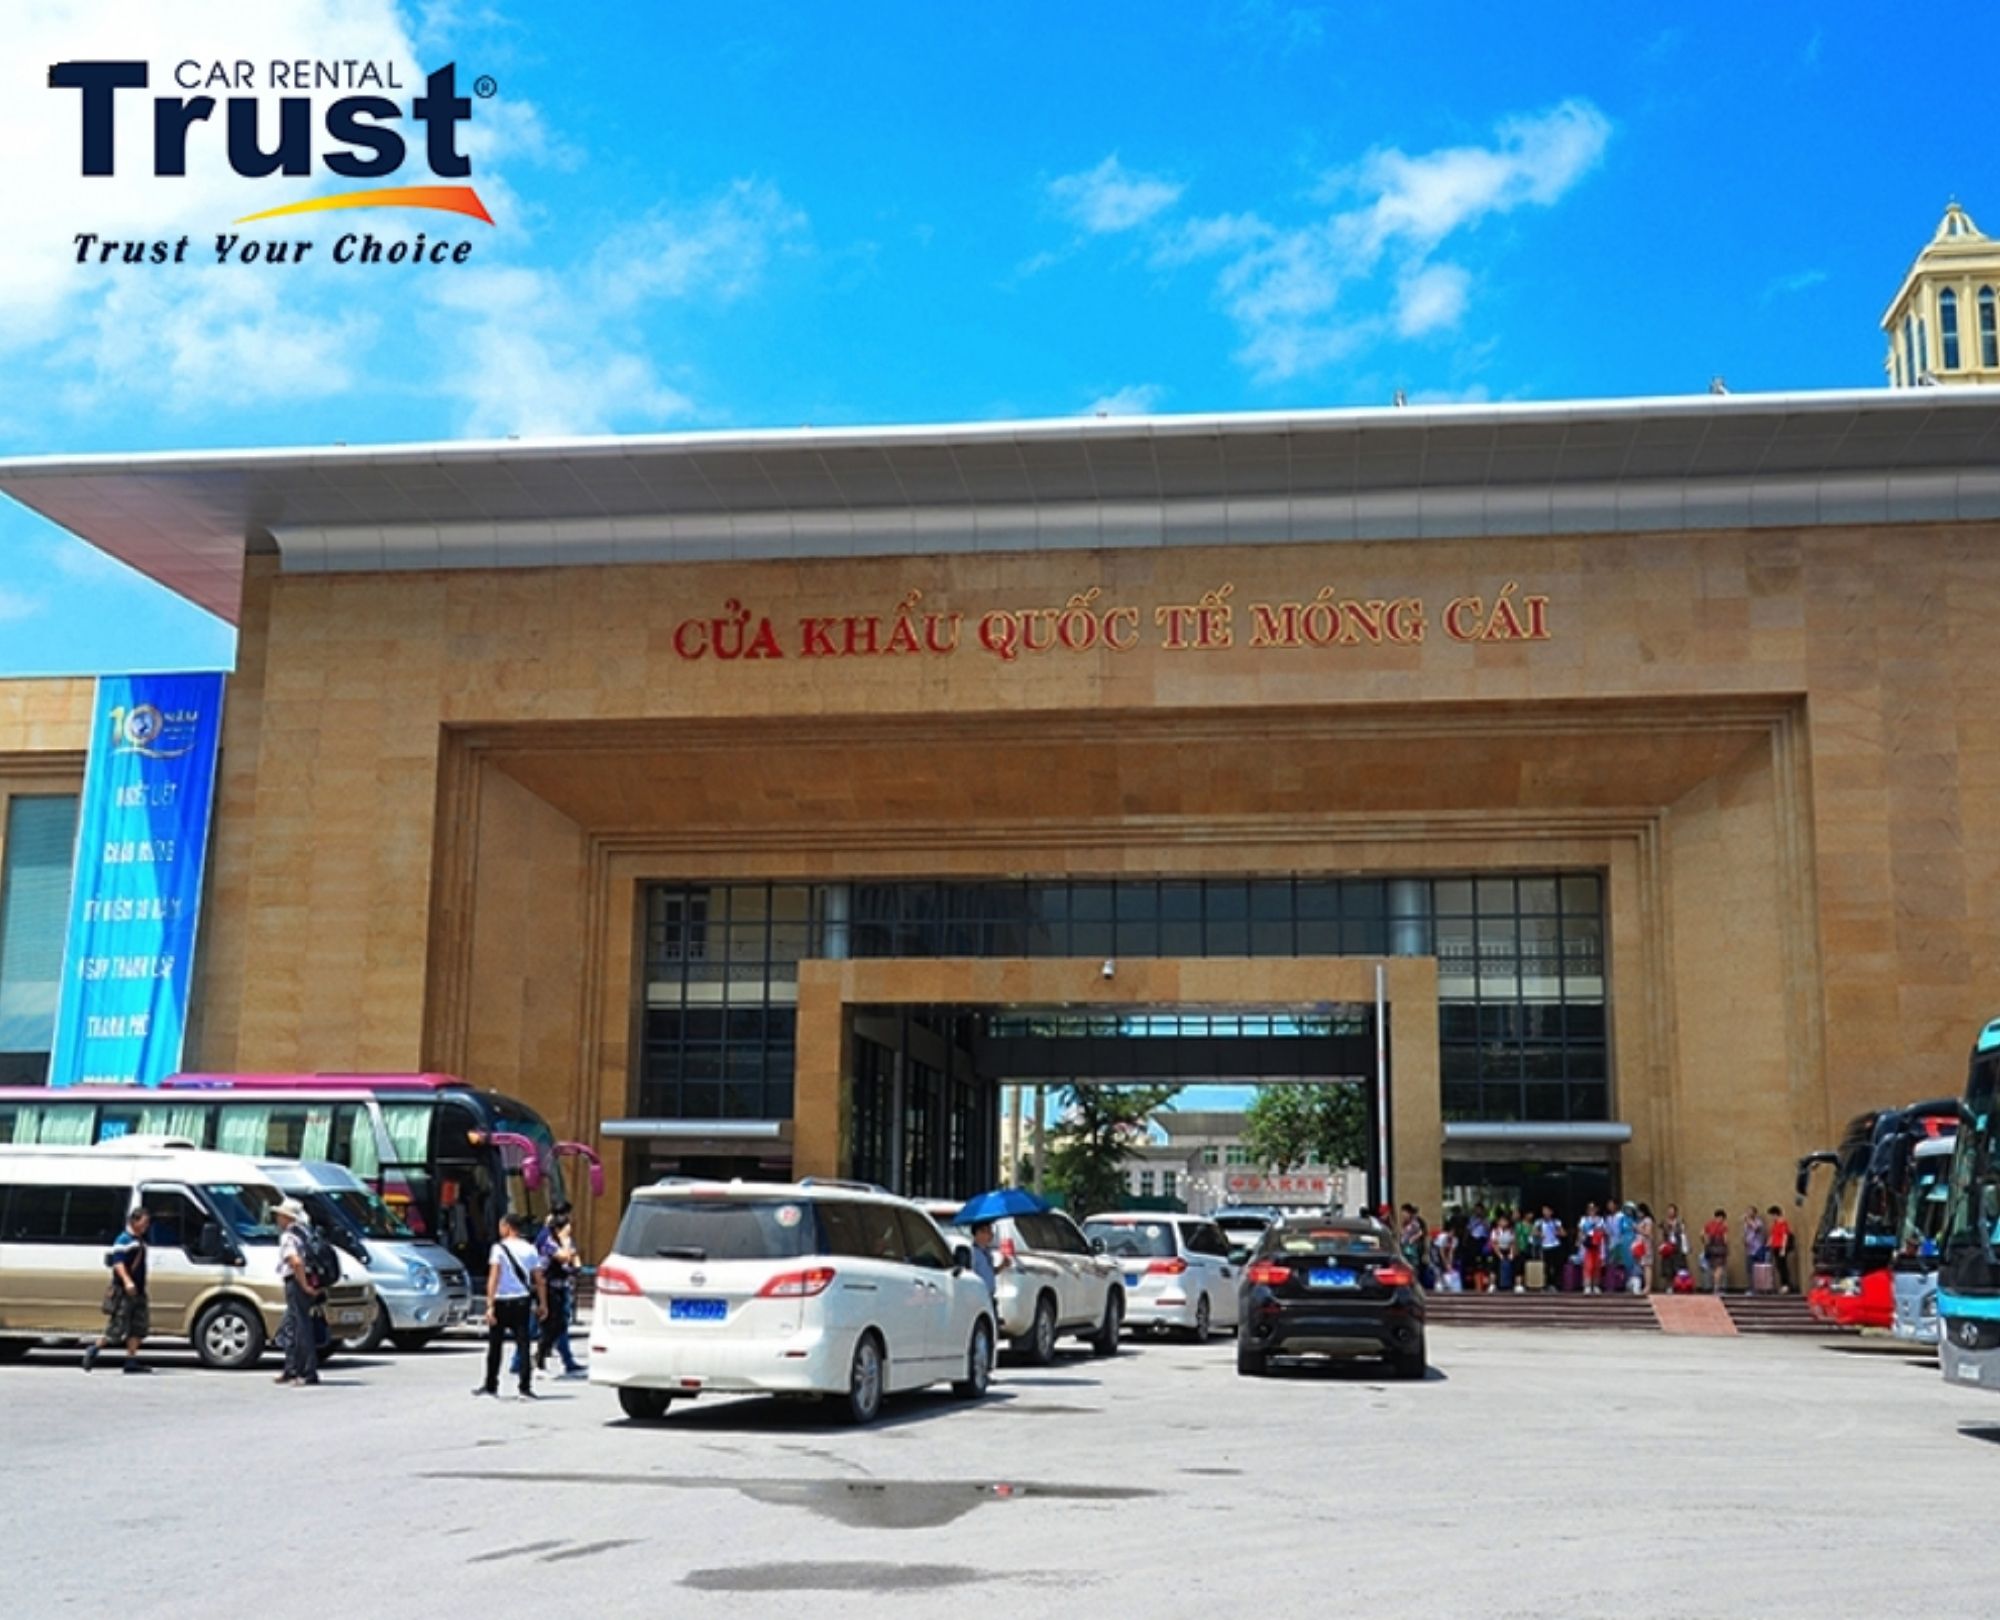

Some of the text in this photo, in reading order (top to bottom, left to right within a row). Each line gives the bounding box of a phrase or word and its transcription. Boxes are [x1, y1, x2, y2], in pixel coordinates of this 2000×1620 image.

[673, 580, 1552, 662] CỬA KHẨU QUỐC TẾ MÓNG CÁI
